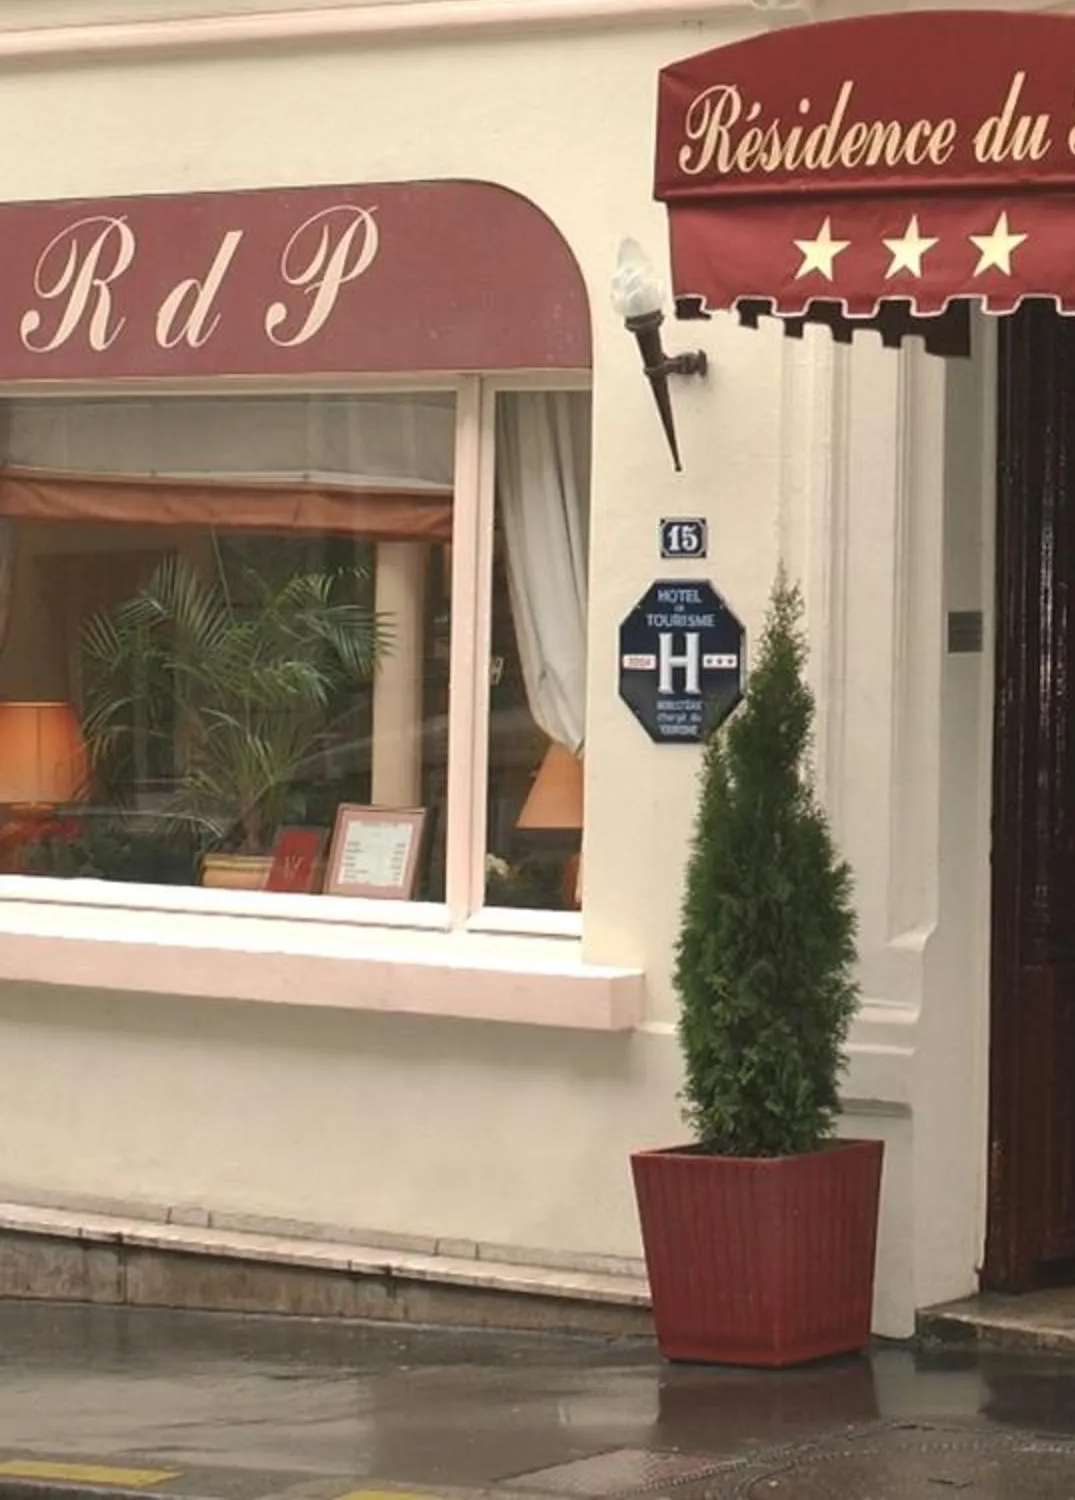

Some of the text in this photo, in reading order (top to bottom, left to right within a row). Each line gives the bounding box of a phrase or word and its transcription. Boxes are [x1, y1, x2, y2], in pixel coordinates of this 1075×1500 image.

[678, 79, 957, 176] Résidence
[972, 70, 1052, 164] du
[667, 524, 699, 551] 15
[657, 588, 703, 603] HOTEL
[645, 613, 717, 628] TOURISME
[657, 631, 702, 695] H
